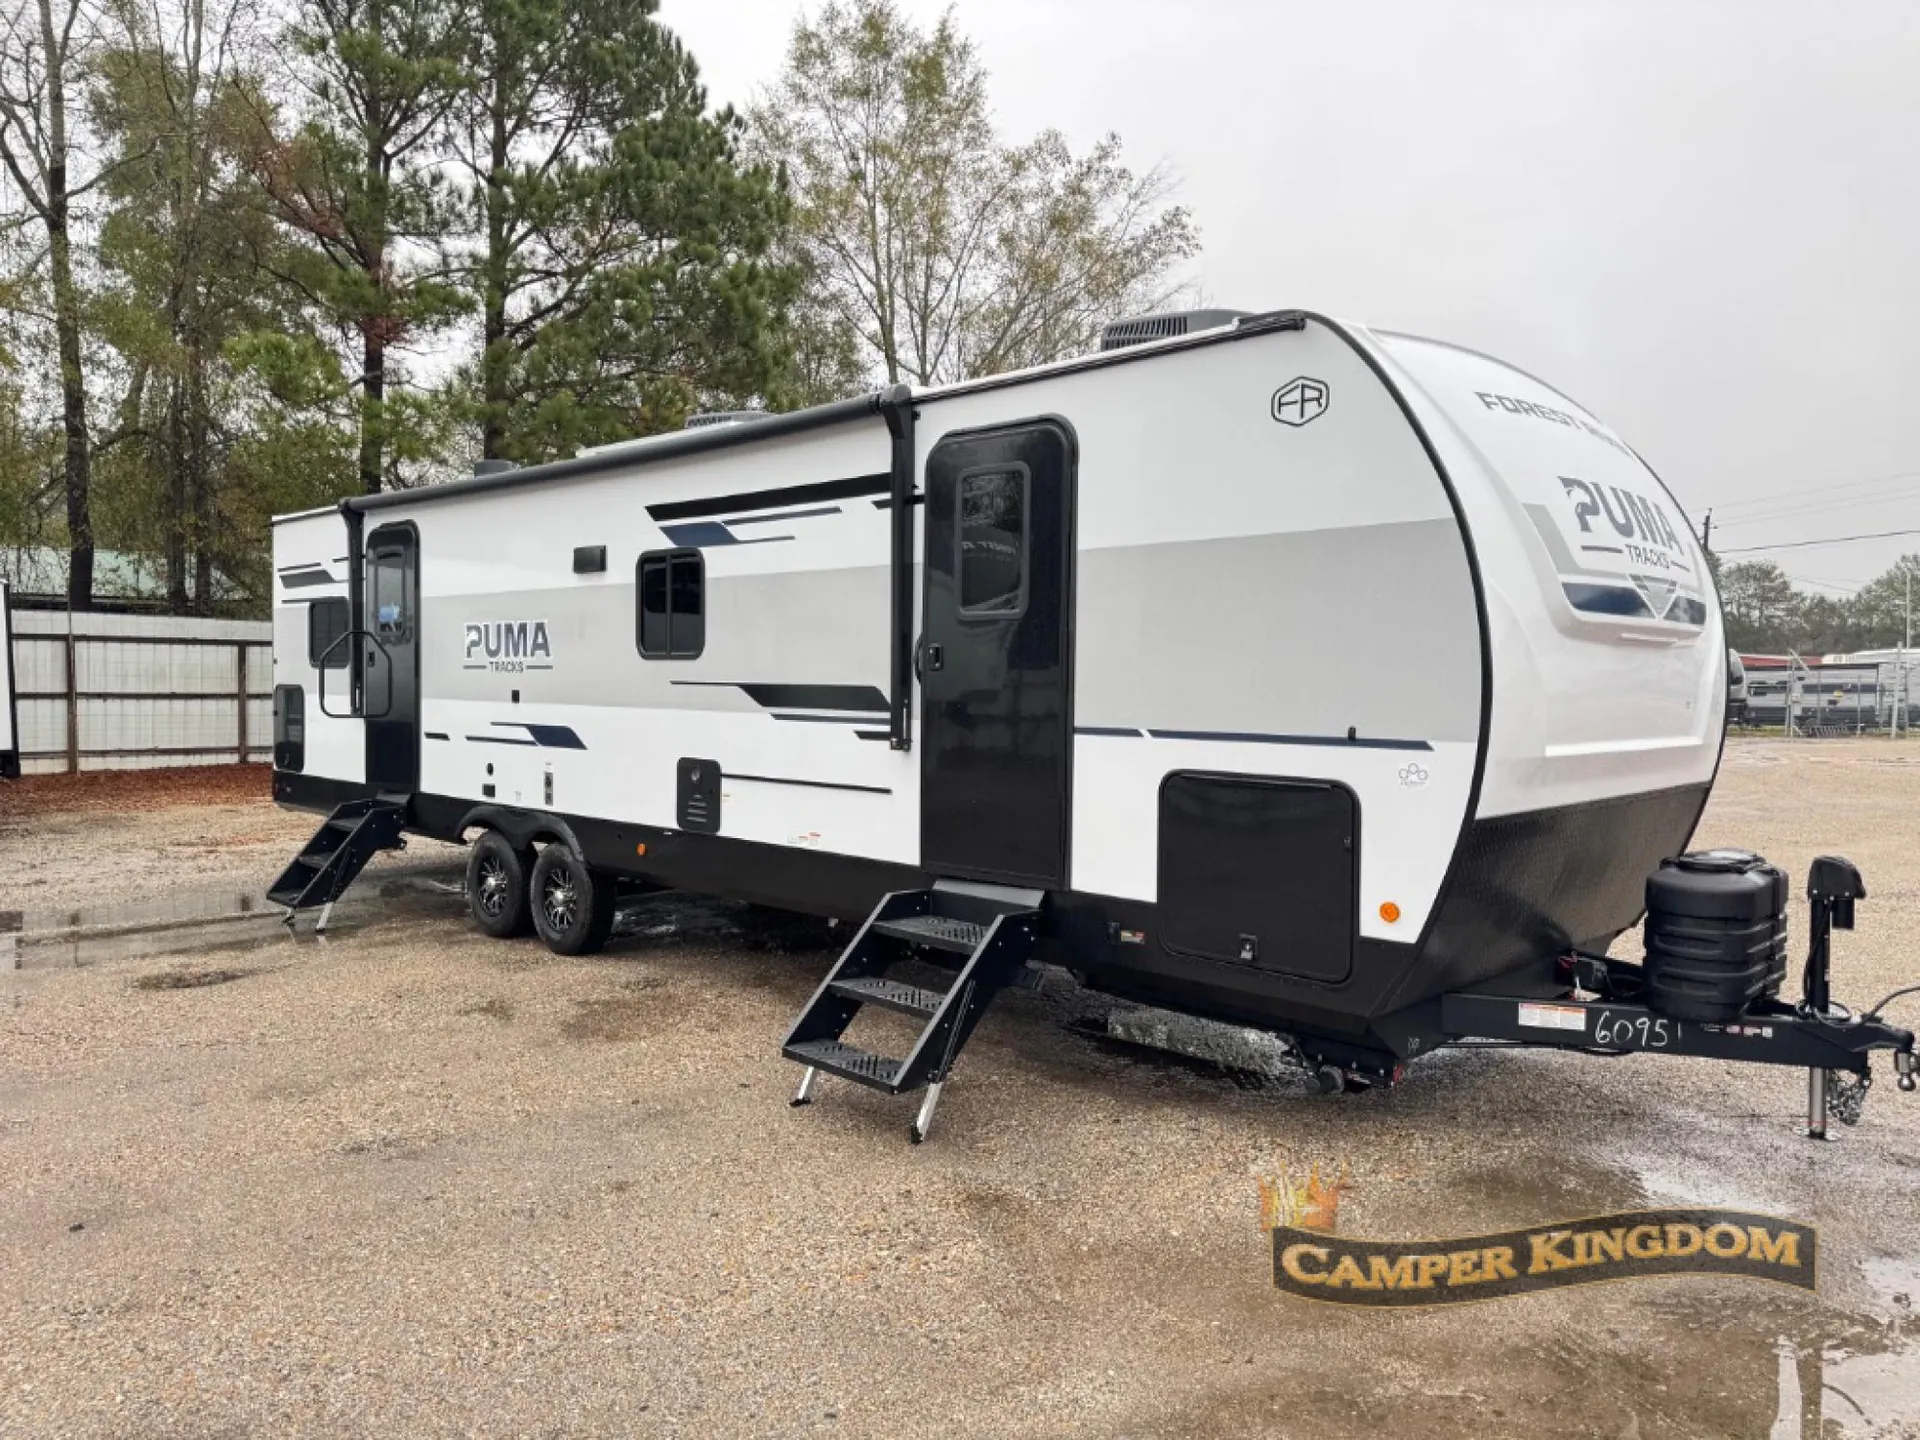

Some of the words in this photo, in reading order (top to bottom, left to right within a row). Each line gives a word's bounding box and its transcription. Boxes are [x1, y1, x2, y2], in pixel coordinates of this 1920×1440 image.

[1474, 391, 1581, 430] FOREST
[1557, 476, 1684, 556] PUMA
[465, 621, 551, 659] PUMA
[488, 661, 524, 674] TRACKS
